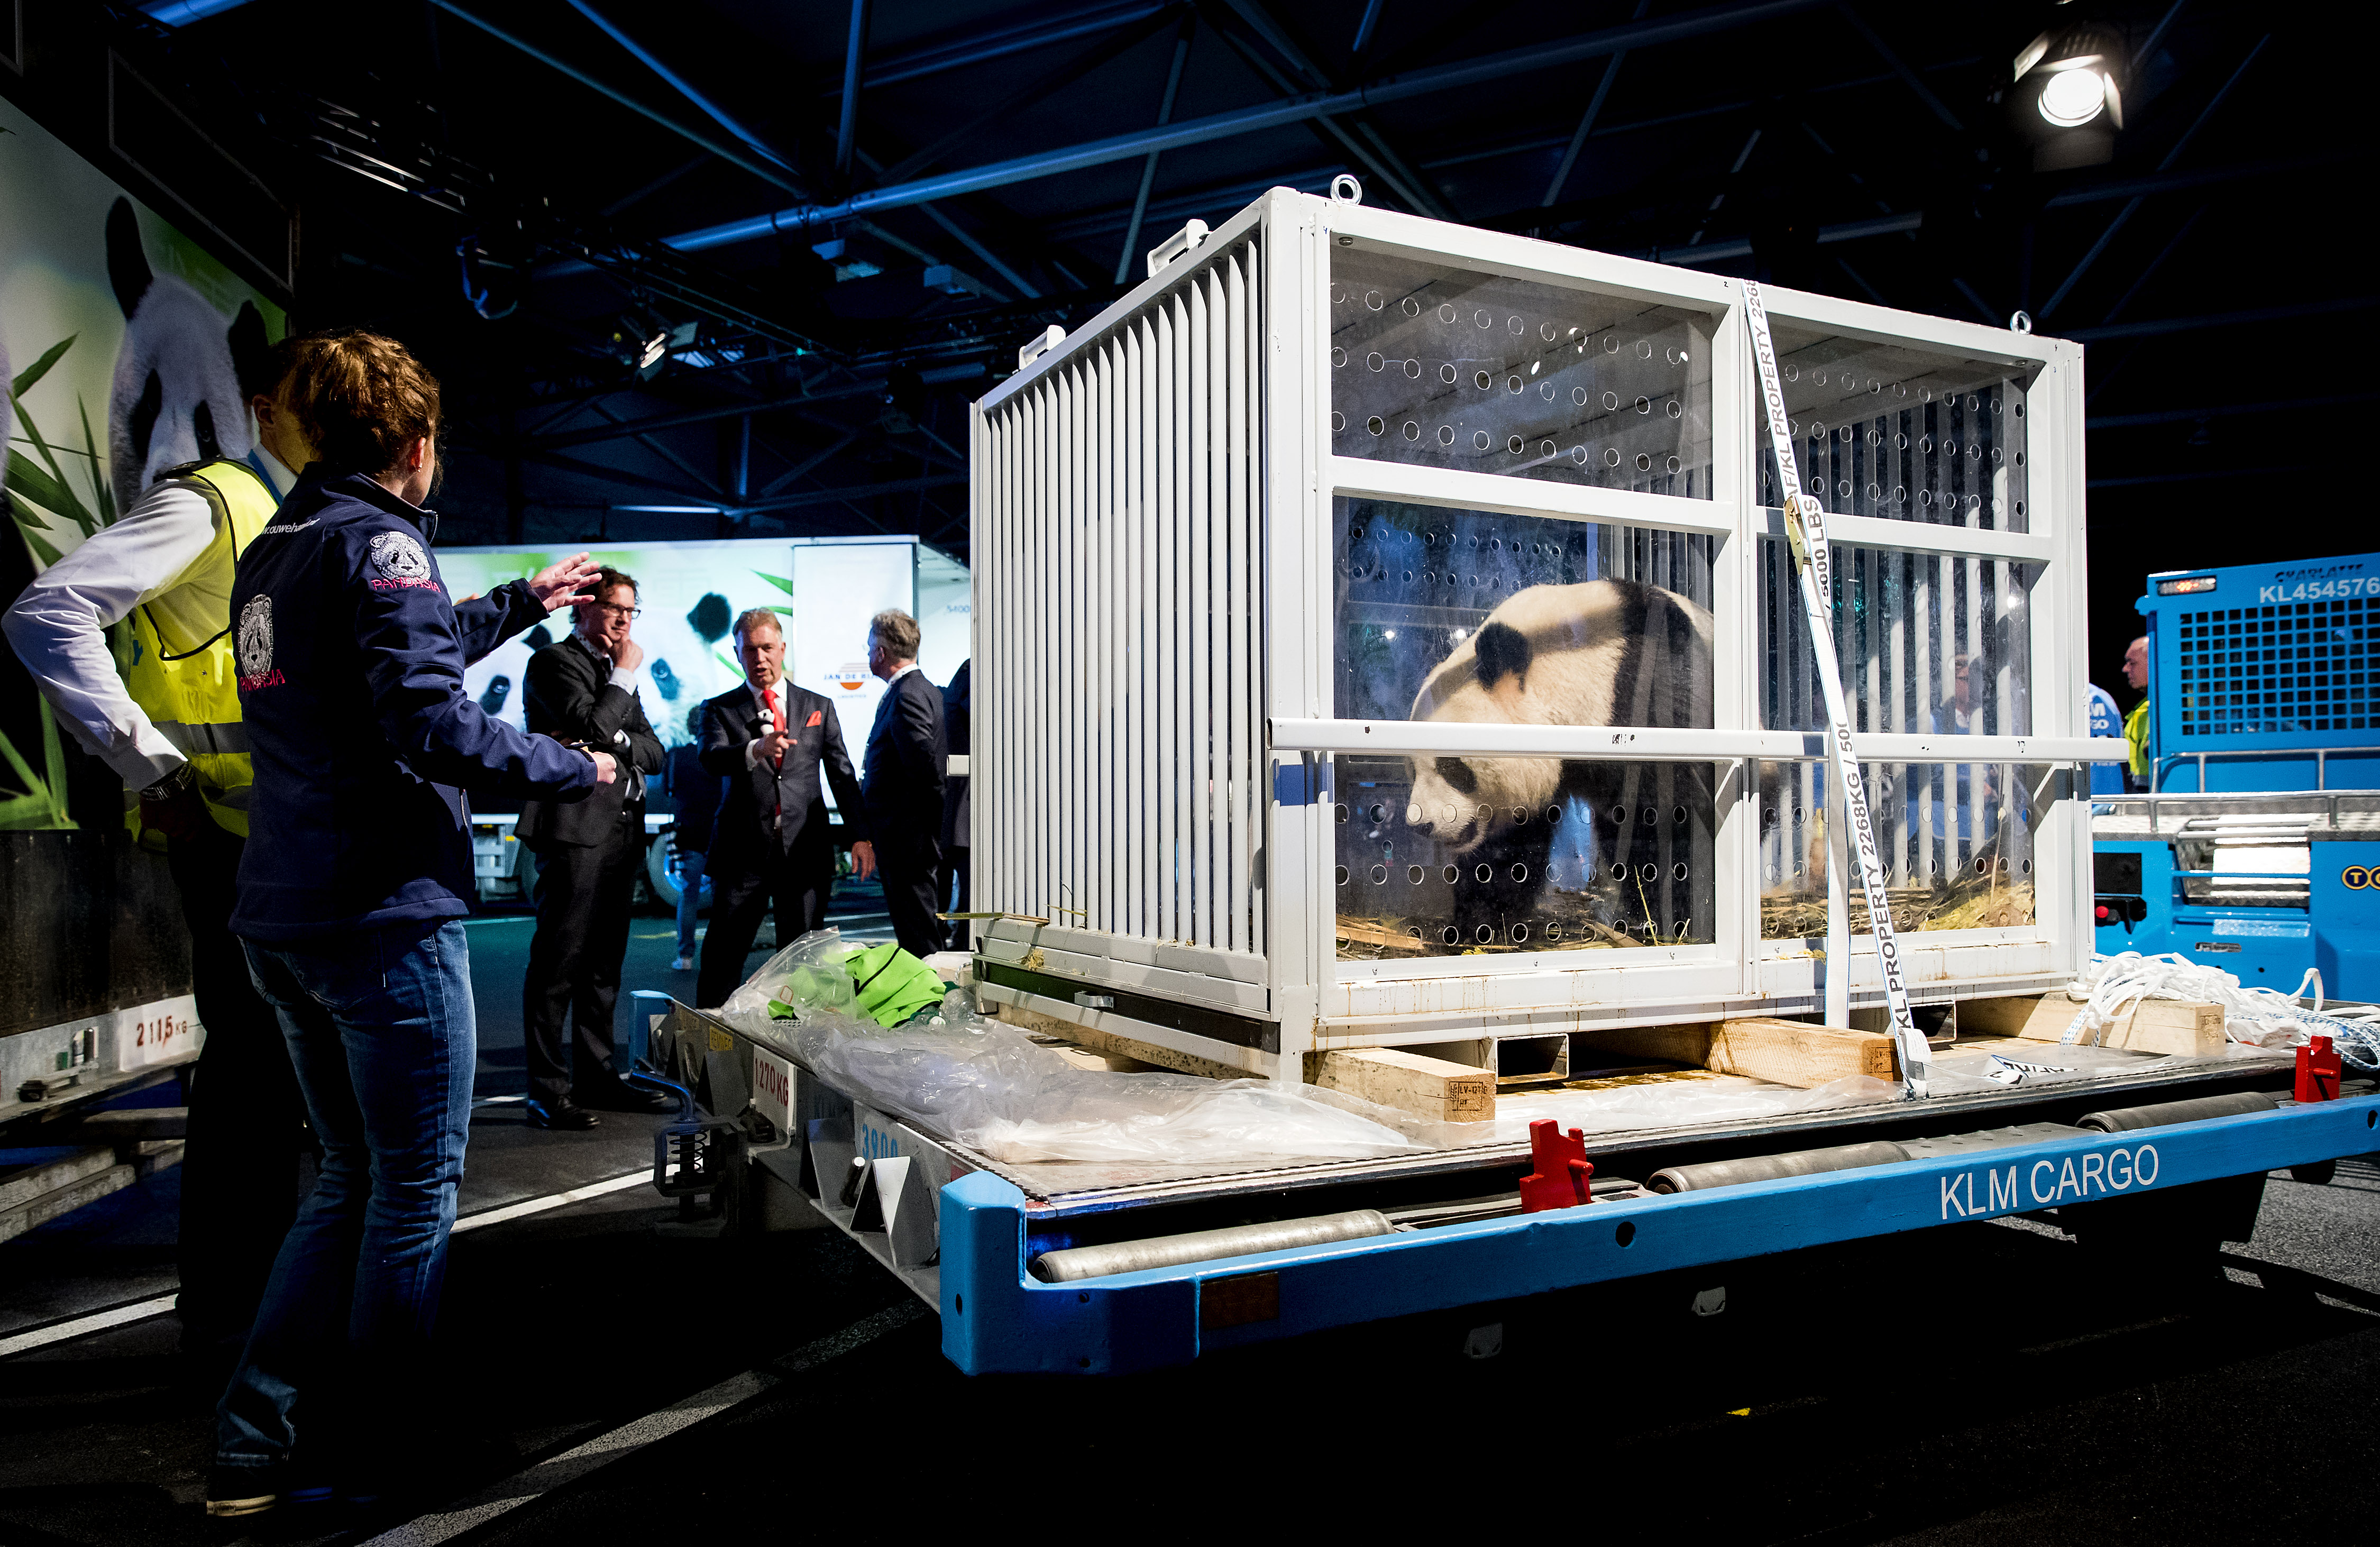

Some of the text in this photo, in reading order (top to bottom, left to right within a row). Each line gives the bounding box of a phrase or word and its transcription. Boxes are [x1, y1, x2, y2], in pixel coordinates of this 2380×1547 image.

[1756, 325, 1787, 436] PROPERTY
[1803, 498, 1825, 542] LBS
[371, 576, 441, 593] PANDASIA
[1815, 548, 1828, 597] 5000
[2259, 576, 2380, 603] KL454576
[240, 669, 286, 693] PANDASIA
[1847, 773, 1876, 856] 2268KG
[1864, 864, 1903, 992] PROPERTY
[136, 1015, 173, 1047] 2115
[1940, 1144, 2159, 1220] KLM CARGO
